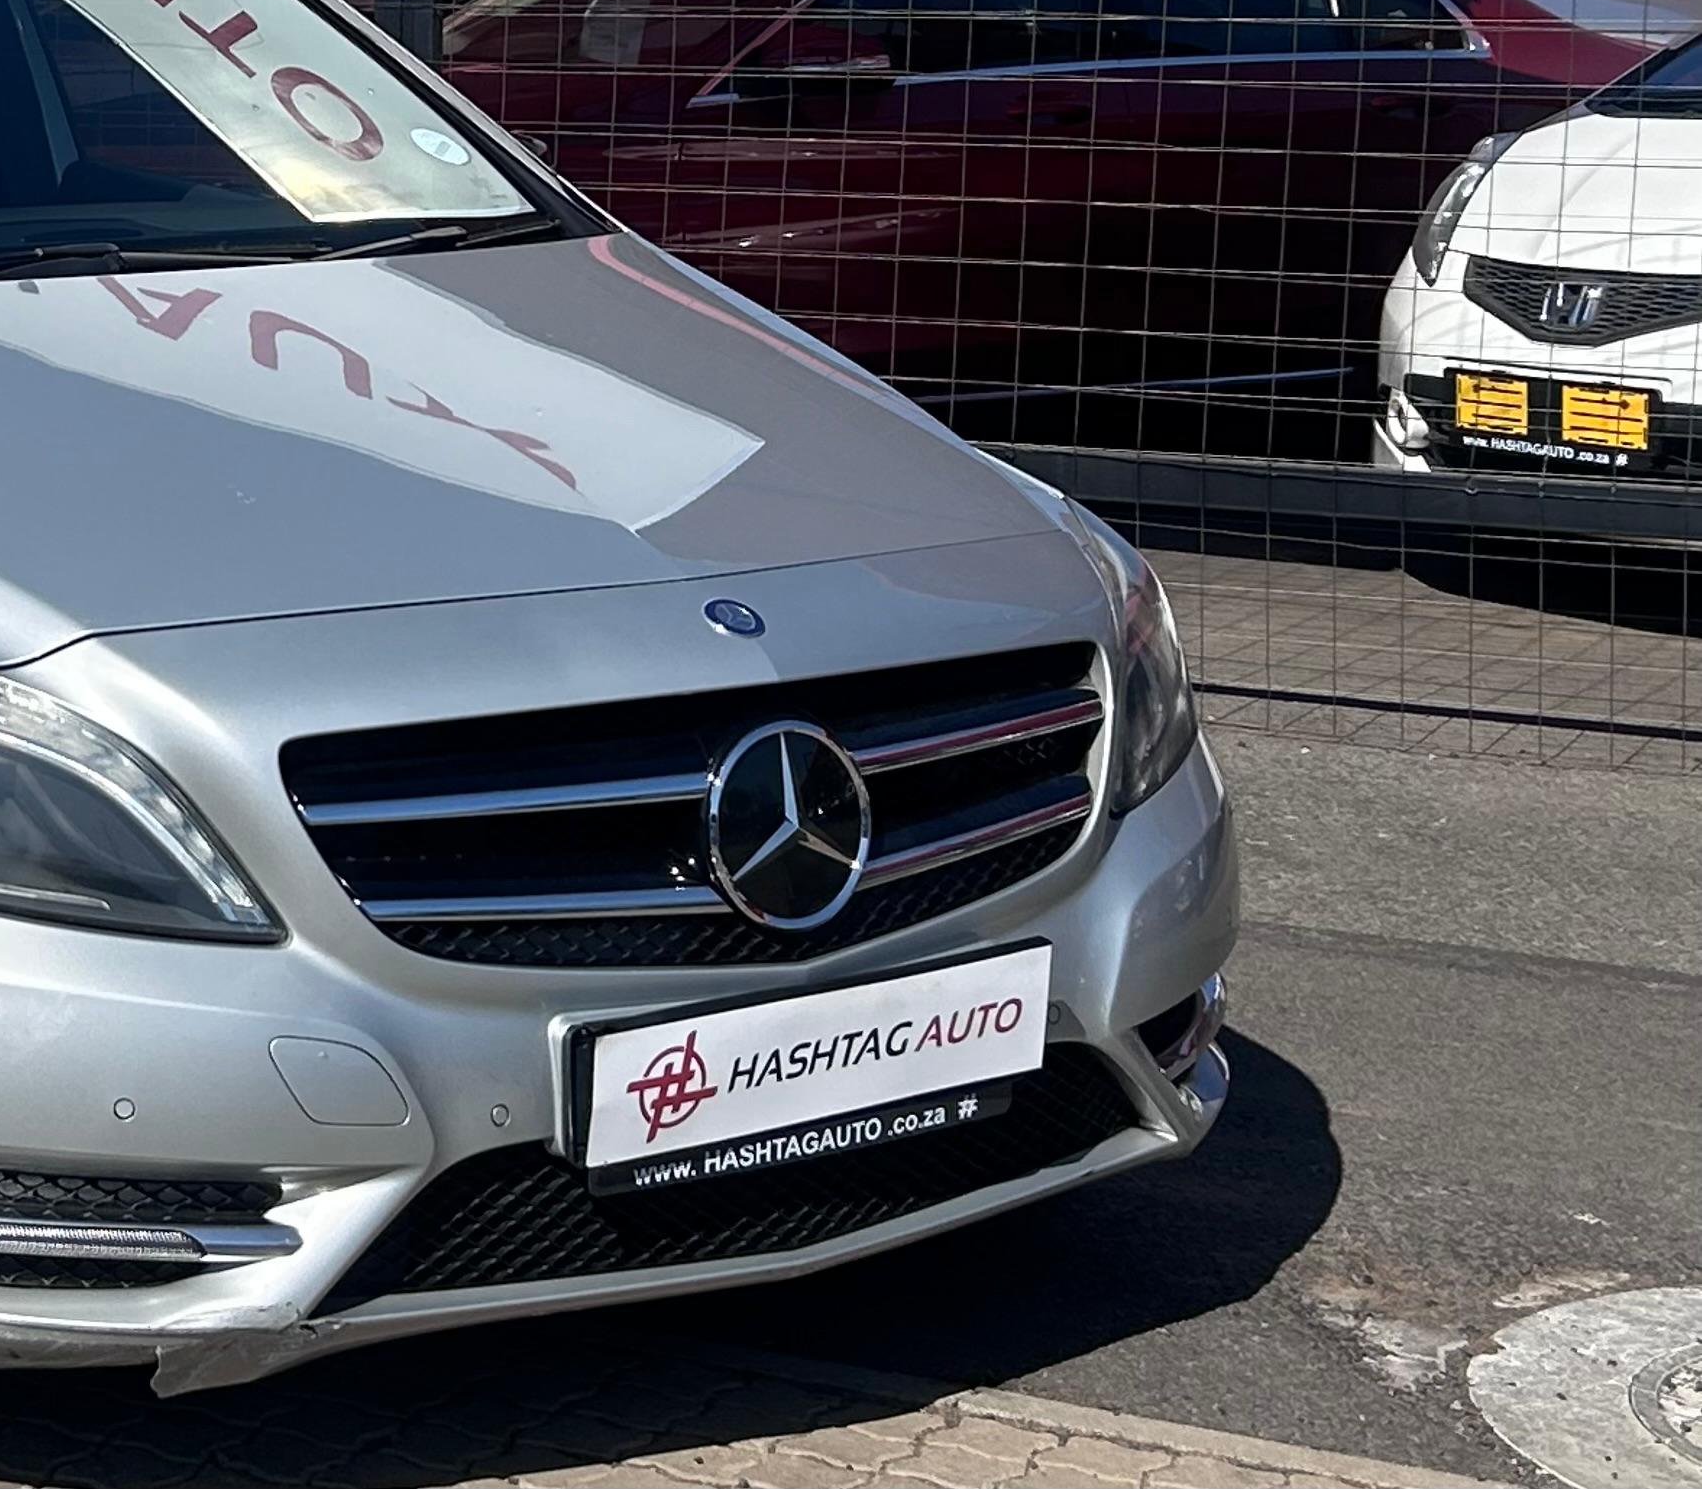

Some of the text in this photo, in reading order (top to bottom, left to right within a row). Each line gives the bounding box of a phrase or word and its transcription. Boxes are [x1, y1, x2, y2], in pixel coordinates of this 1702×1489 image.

[1491, 437, 1575, 460] HASHTAGAUTO
[727, 997, 1023, 1094] HASHTAG AUTO
[633, 1159, 697, 1187] www.
[703, 1118, 883, 1174] HASHTAGAUTO
[887, 1105, 947, 1137] .co.za
